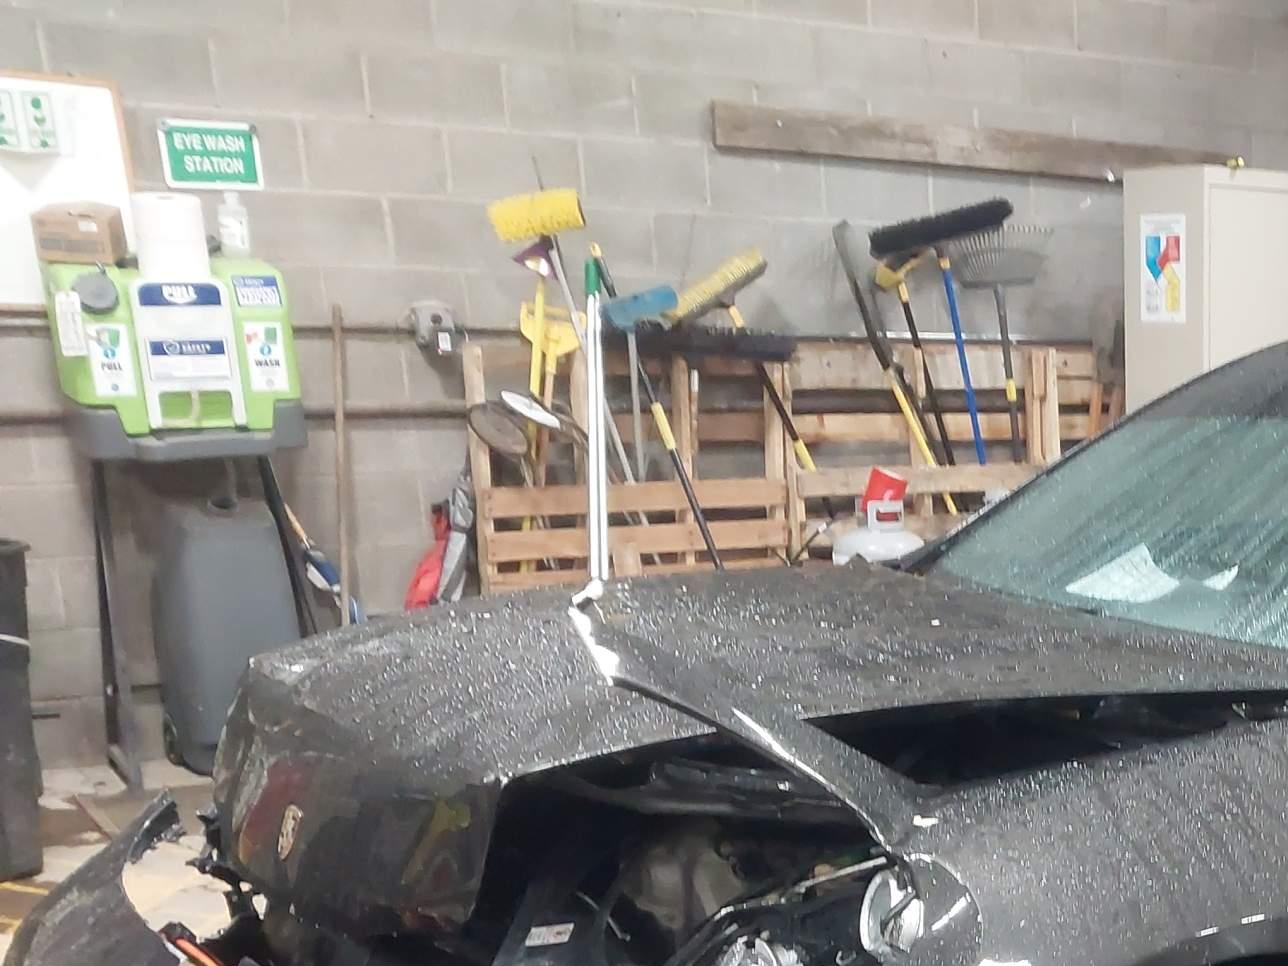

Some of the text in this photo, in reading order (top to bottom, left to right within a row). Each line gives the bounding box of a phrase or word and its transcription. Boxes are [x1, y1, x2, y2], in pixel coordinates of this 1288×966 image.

[172, 132, 246, 153] EYE WASH
[183, 154, 245, 175] STATION
[254, 359, 281, 367] WASH
